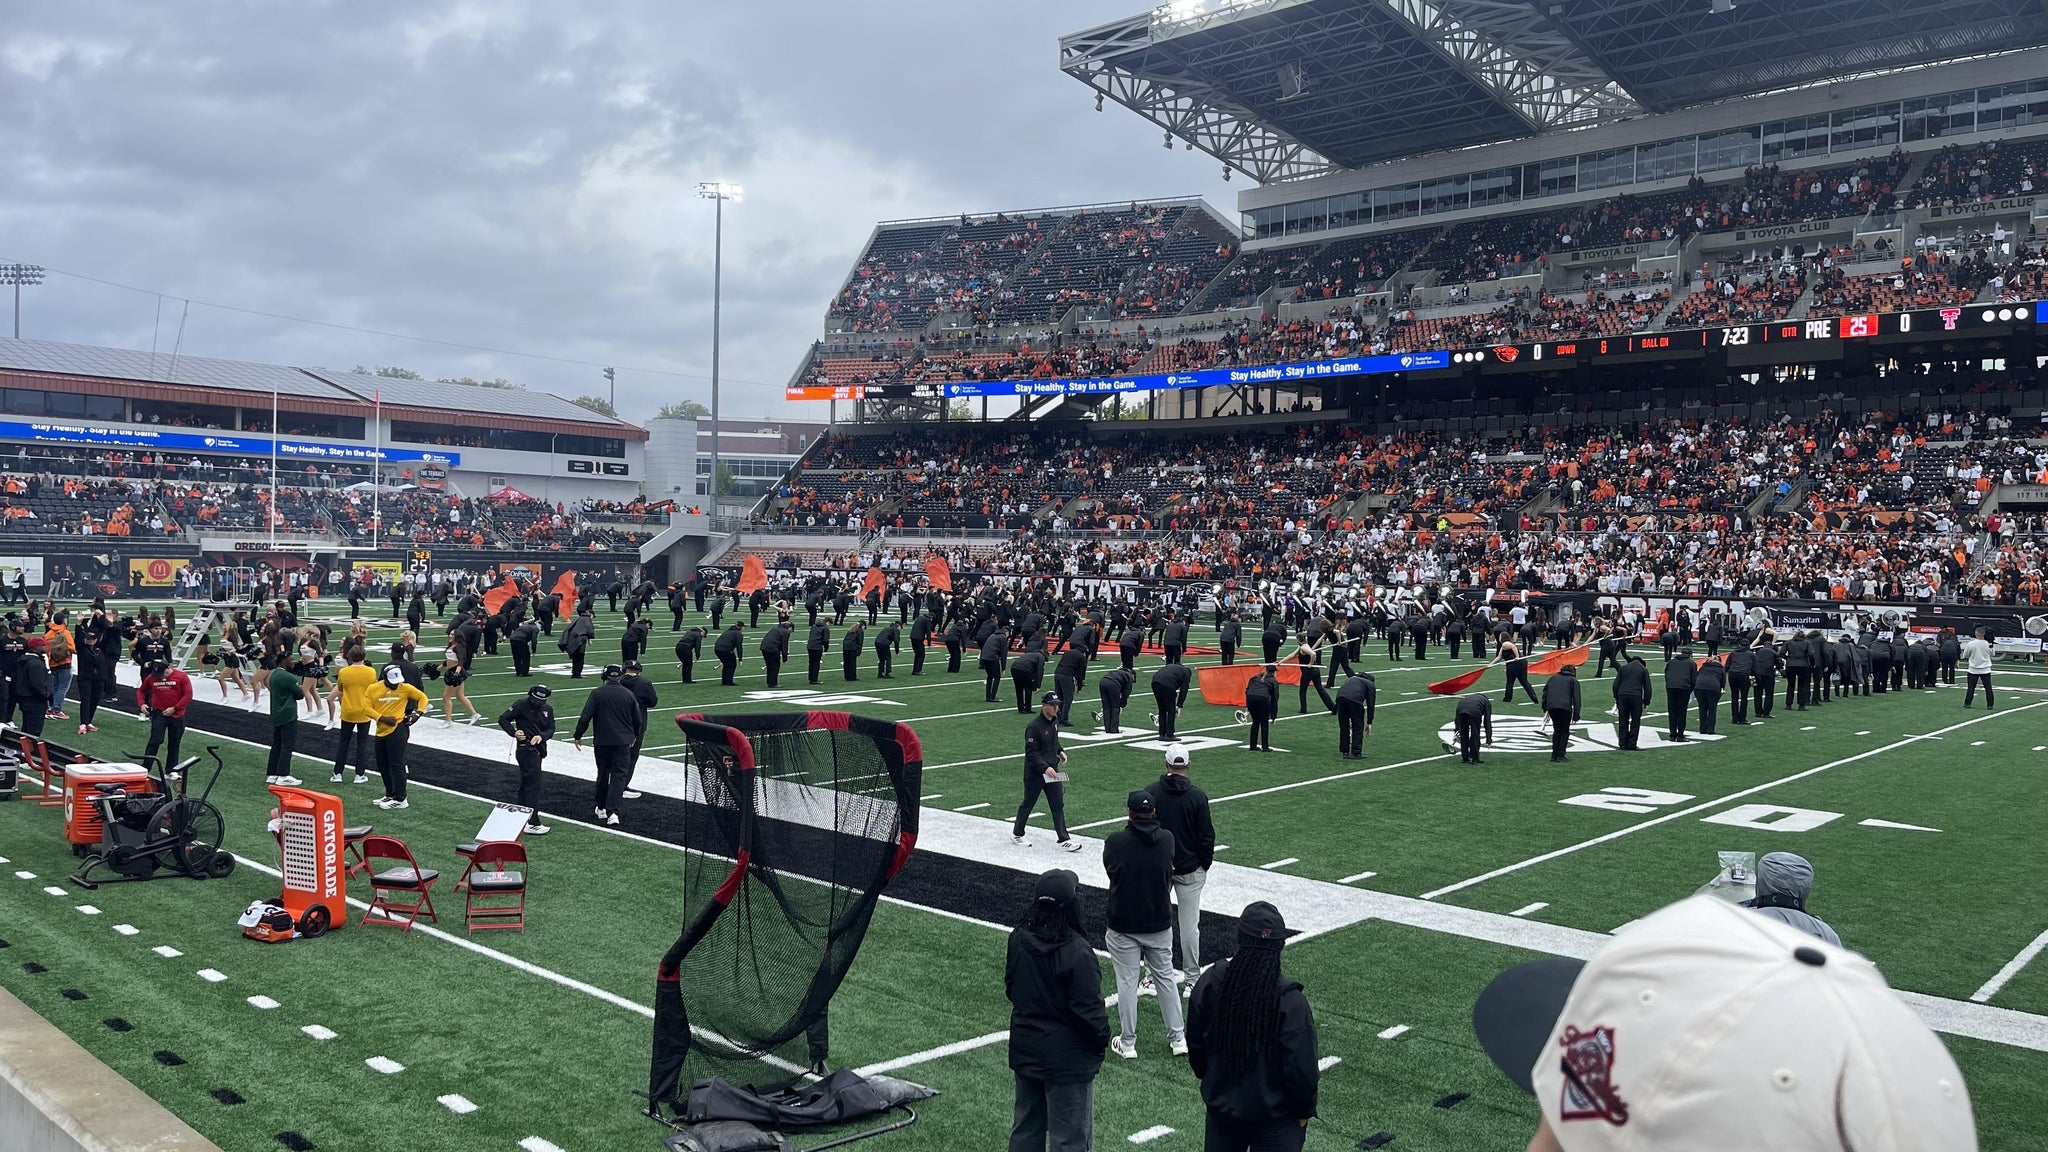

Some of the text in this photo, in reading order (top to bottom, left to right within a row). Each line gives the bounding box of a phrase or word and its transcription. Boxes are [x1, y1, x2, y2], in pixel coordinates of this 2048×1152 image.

[1946, 203, 1996, 215] TOYOTA
[1751, 221, 1830, 239] TOYOTA CLUB
[1583, 248, 1621, 260] TOYOTA
[1805, 319, 1831, 339] PRE
[1850, 317, 1867, 336] 25
[1900, 313, 1910, 332] 0
[1641, 337, 1669, 348] BALL ON
[1721, 326, 1749, 346] 7:23
[1533, 343, 1542, 360] 0
[1230, 362, 1361, 382] Stay Healthy. Stay in the Game.
[1015, 380, 1137, 394] Stay Healthy. Stay in the Game.
[281, 444, 298, 454] Stay
[299, 445, 328, 456] Healthy.
[329, 448, 345, 457] Stay
[346, 448, 353, 456] in
[354, 449, 365, 457] the
[592, 460, 605, 475] 11
[413, 551, 430, 559] 7:23
[410, 559, 428, 572] 25
[1783, 616, 1820, 624] Samaritan
[323, 809, 338, 899] GATORADE
